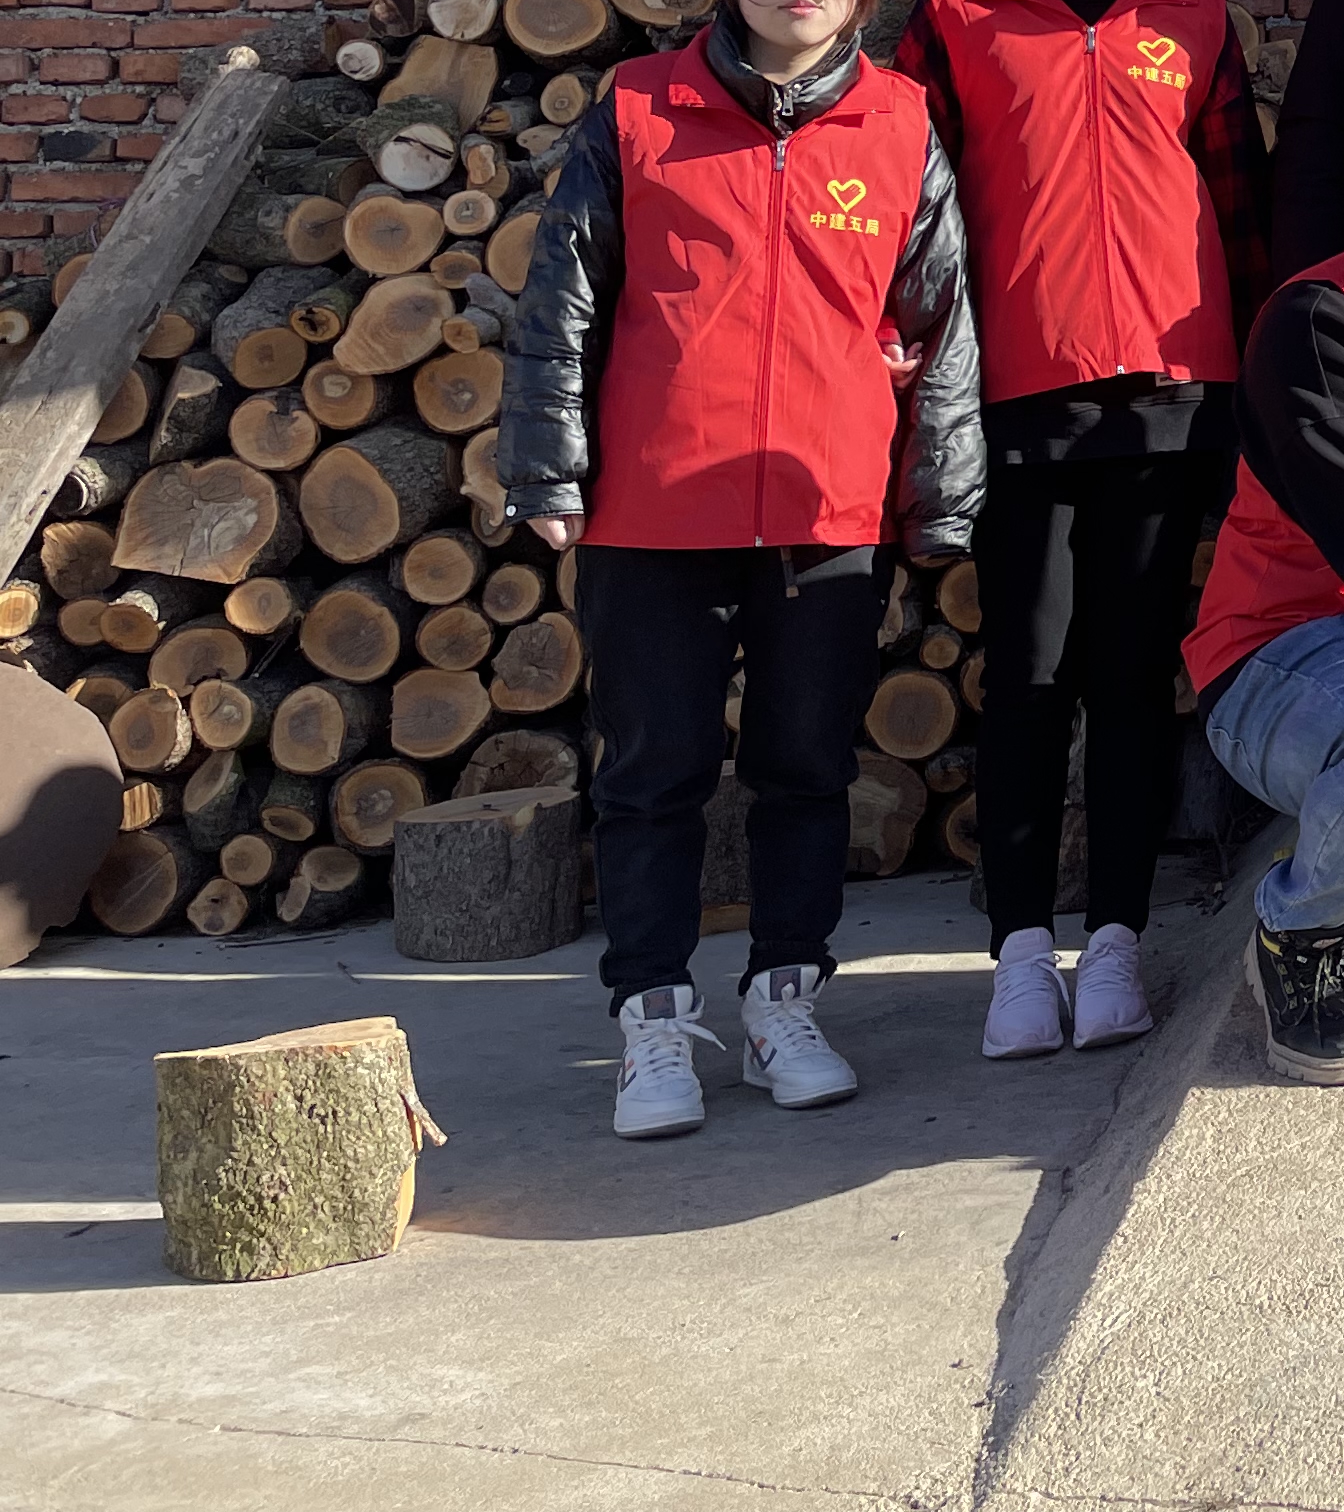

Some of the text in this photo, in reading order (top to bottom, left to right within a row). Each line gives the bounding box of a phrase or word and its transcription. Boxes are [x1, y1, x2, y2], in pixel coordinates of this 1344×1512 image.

[1127, 65, 1187, 90] 中建五局
[809, 211, 880, 237] 中建五局
